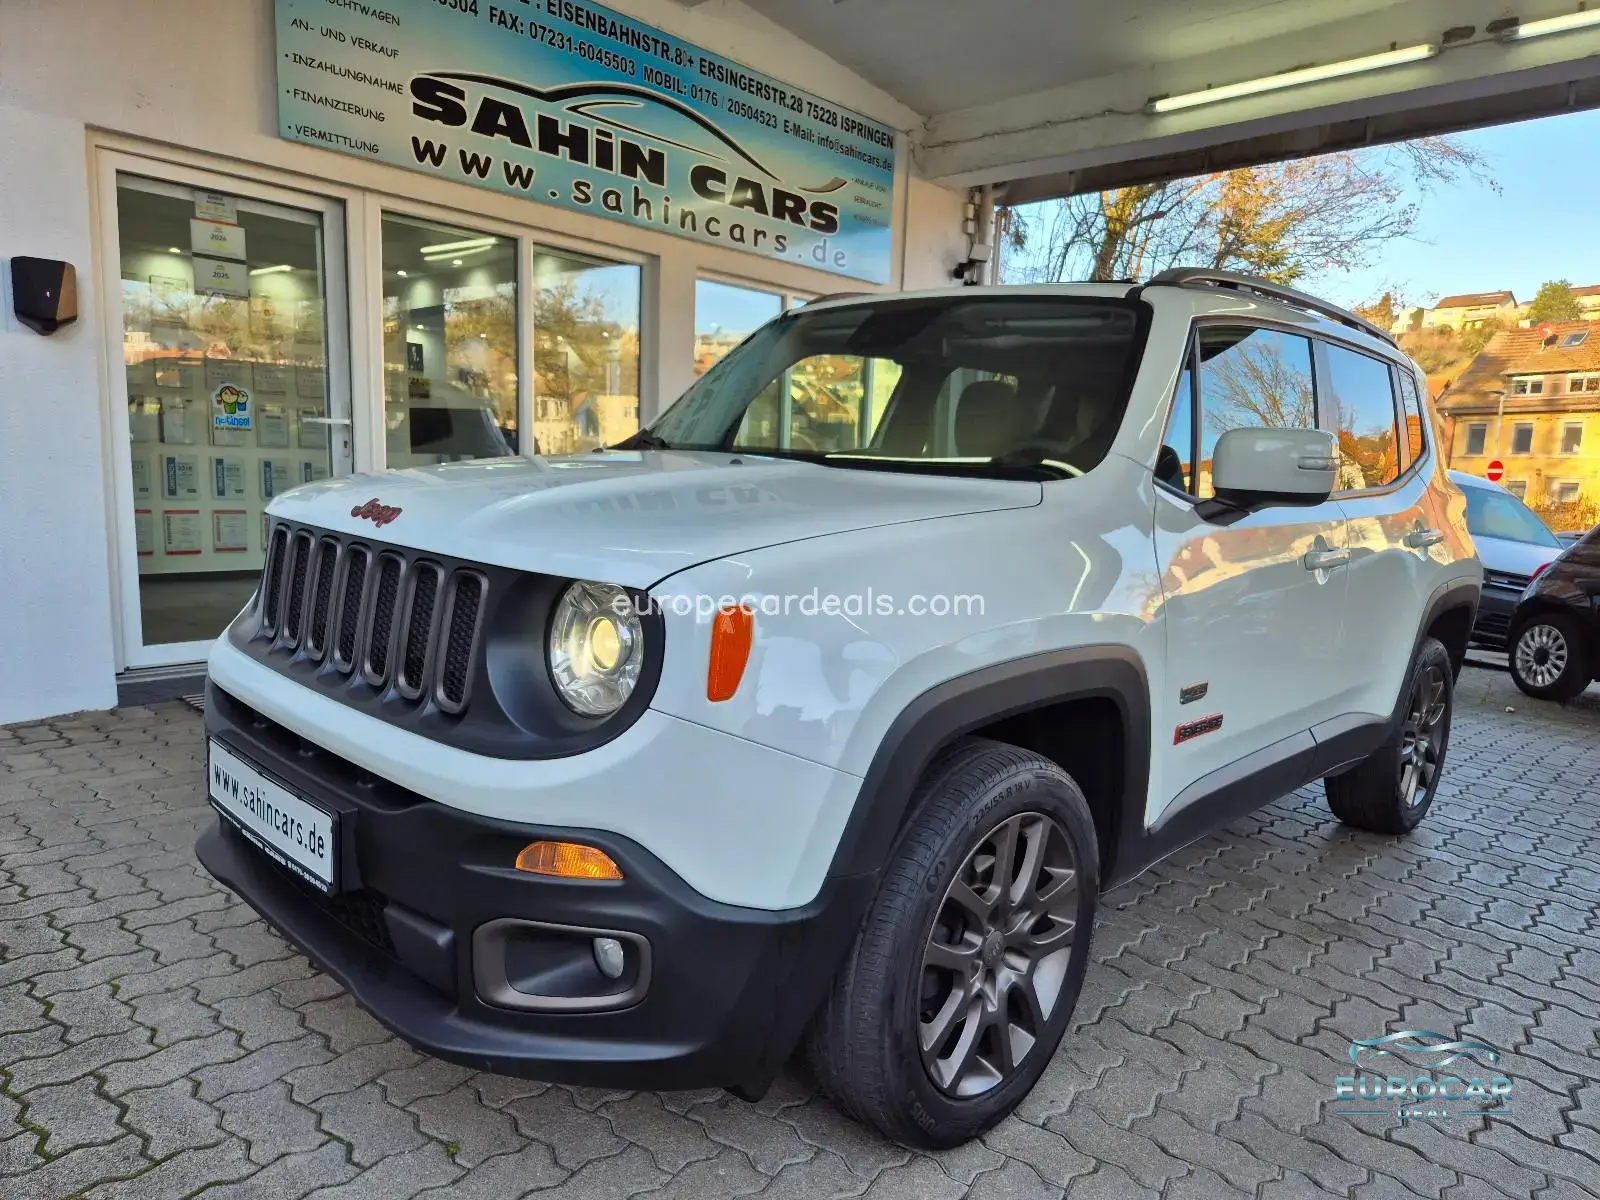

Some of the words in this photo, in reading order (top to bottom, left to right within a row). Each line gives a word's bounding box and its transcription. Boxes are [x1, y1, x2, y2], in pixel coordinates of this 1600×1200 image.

[290, 18, 315, 31] AN-
[320, 26, 346, 43] UND
[350, 35, 400, 60] VERKAUF
[291, 52, 404, 95] INZAHLUNGNAHME
[489, 5, 524, 35] FAX:
[529, 21, 635, 76] 07231-6045503
[643, 65, 687, 96] MOBIL:
[690, 84, 718, 107] 0176
[727, 98, 778, 129] 20504523
[783, 119, 815, 144] E-Mail:
[817, 132, 893, 172] info@sahincars.de
[293, 88, 386, 122] FINANZIERUNG
[699, 56, 803, 114] ERSINGERSTR.28
[806, 101, 838, 127] 75228
[840, 115, 894, 150] ISPRINGEN
[295, 124, 380, 154] VERMITTLUNG
[690, 165, 838, 234] CARS
[214, 763, 325, 859] www.sahincars.de
